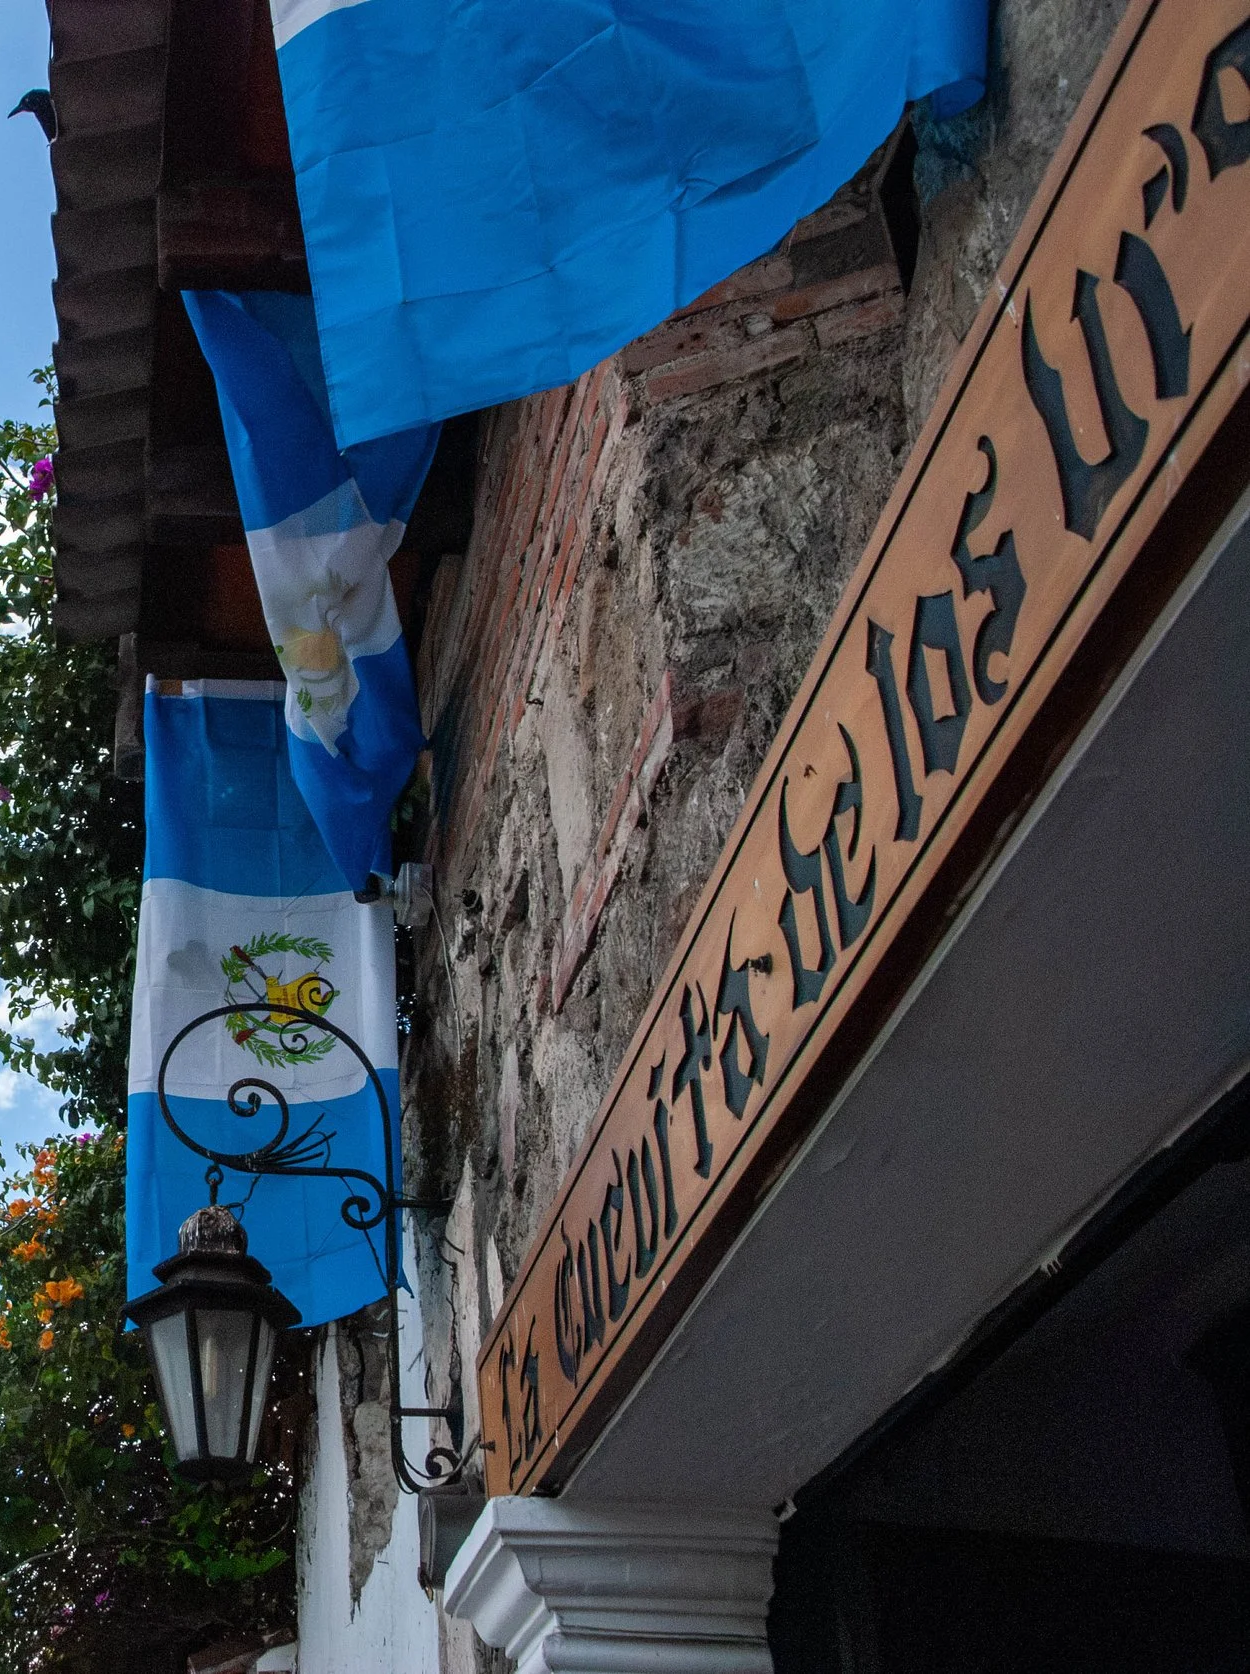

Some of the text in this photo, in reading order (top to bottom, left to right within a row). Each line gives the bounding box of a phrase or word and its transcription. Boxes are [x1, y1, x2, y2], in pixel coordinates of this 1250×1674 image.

[498, 1314, 545, 1490] La
[553, 905, 771, 1389] Cuevita
[778, 721, 877, 1012] de
[864, 434, 1028, 843] los
